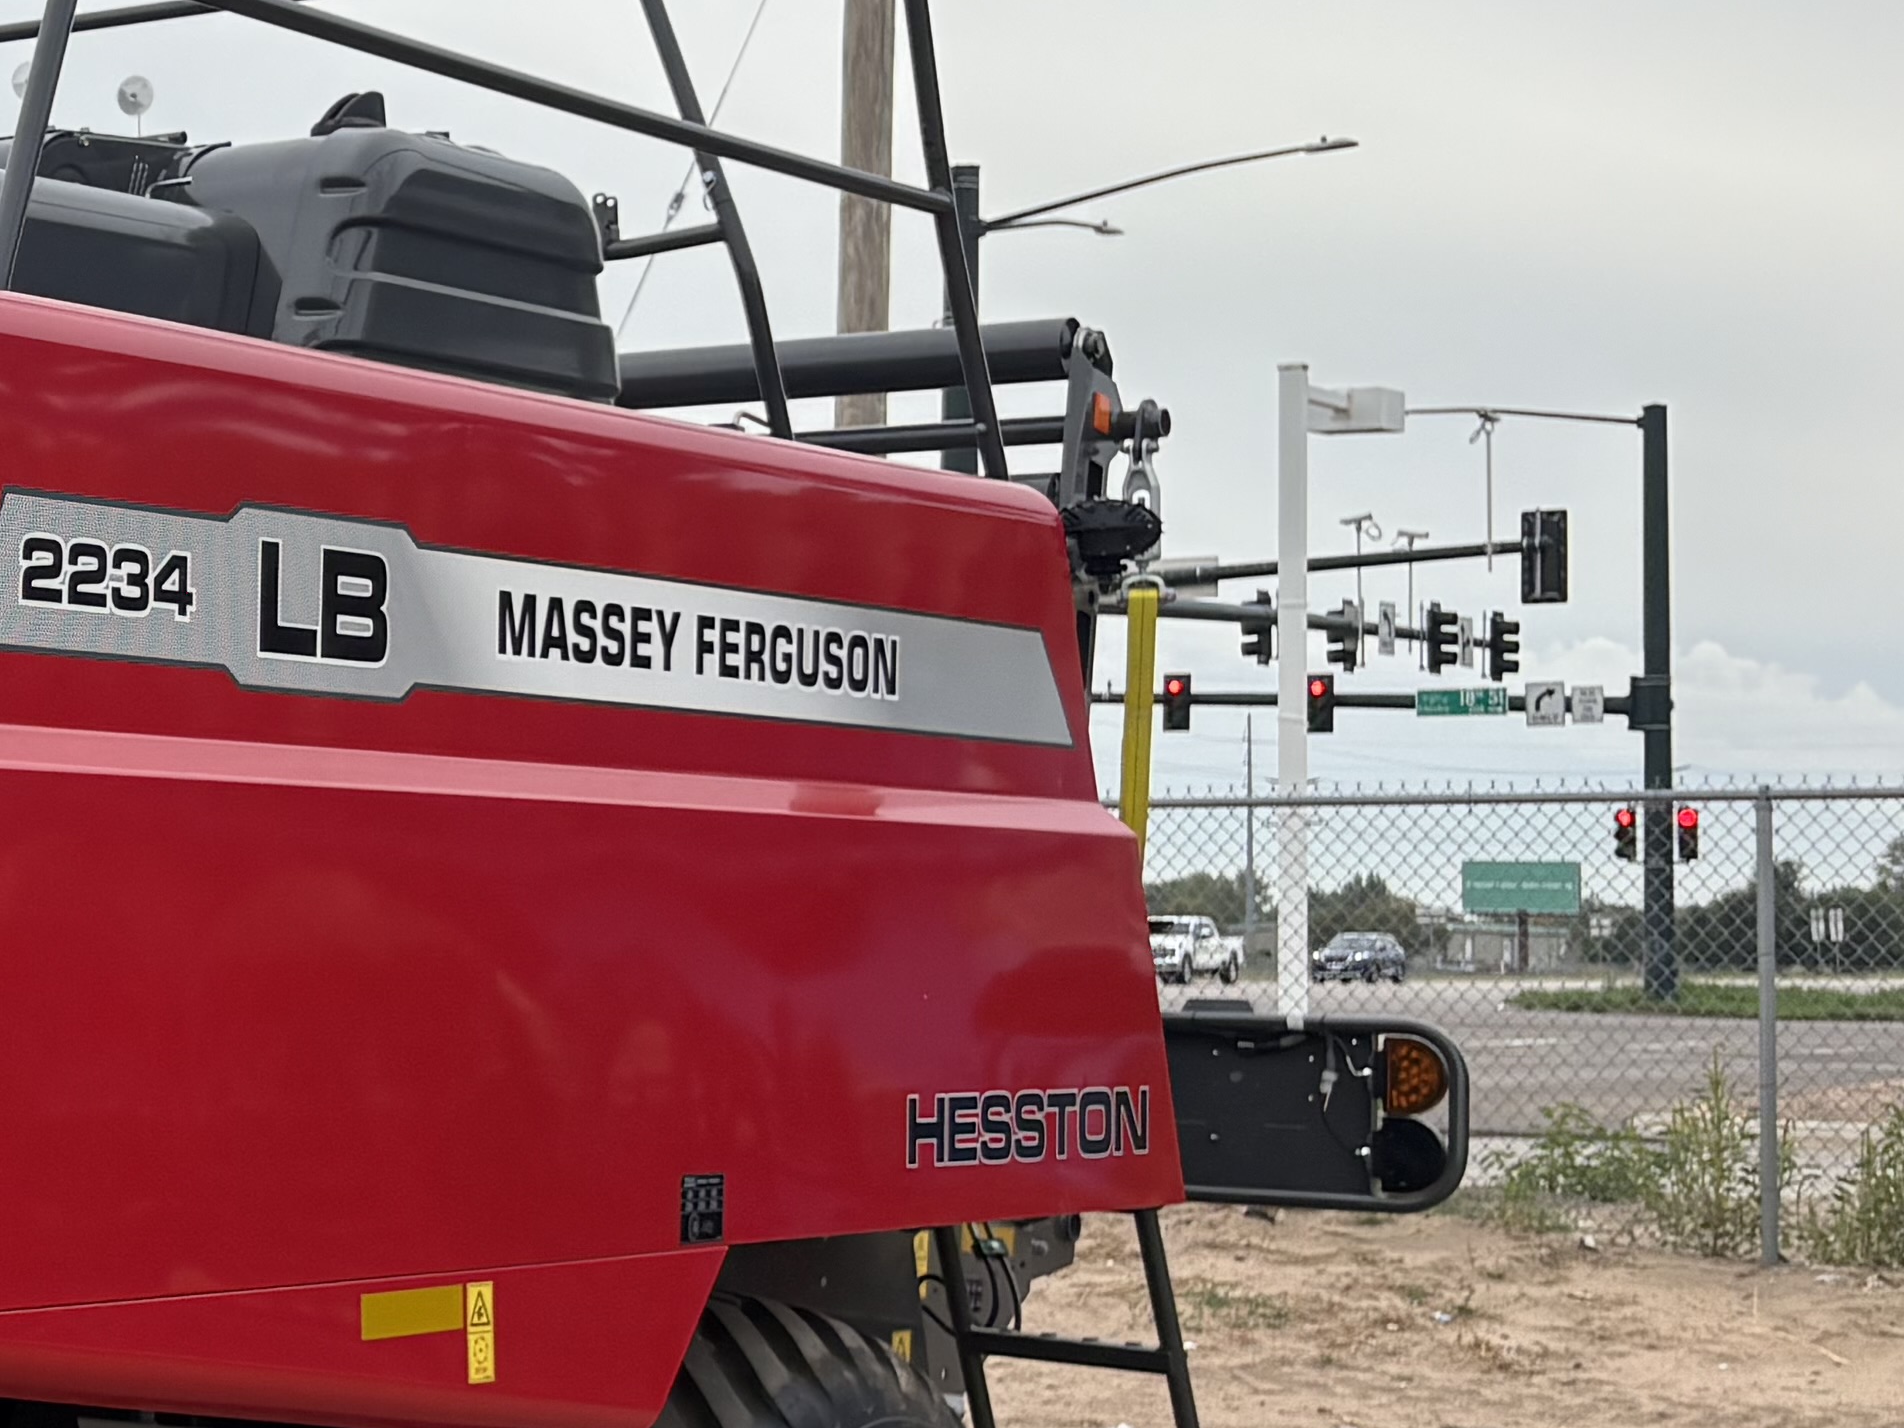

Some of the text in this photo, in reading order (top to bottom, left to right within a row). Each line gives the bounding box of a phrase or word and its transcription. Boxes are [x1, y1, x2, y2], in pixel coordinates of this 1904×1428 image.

[19, 532, 390, 665] 2234 LB
[496, 590, 900, 700] MASSEY FERGUSON
[906, 1085, 1149, 1169] HESSTON
